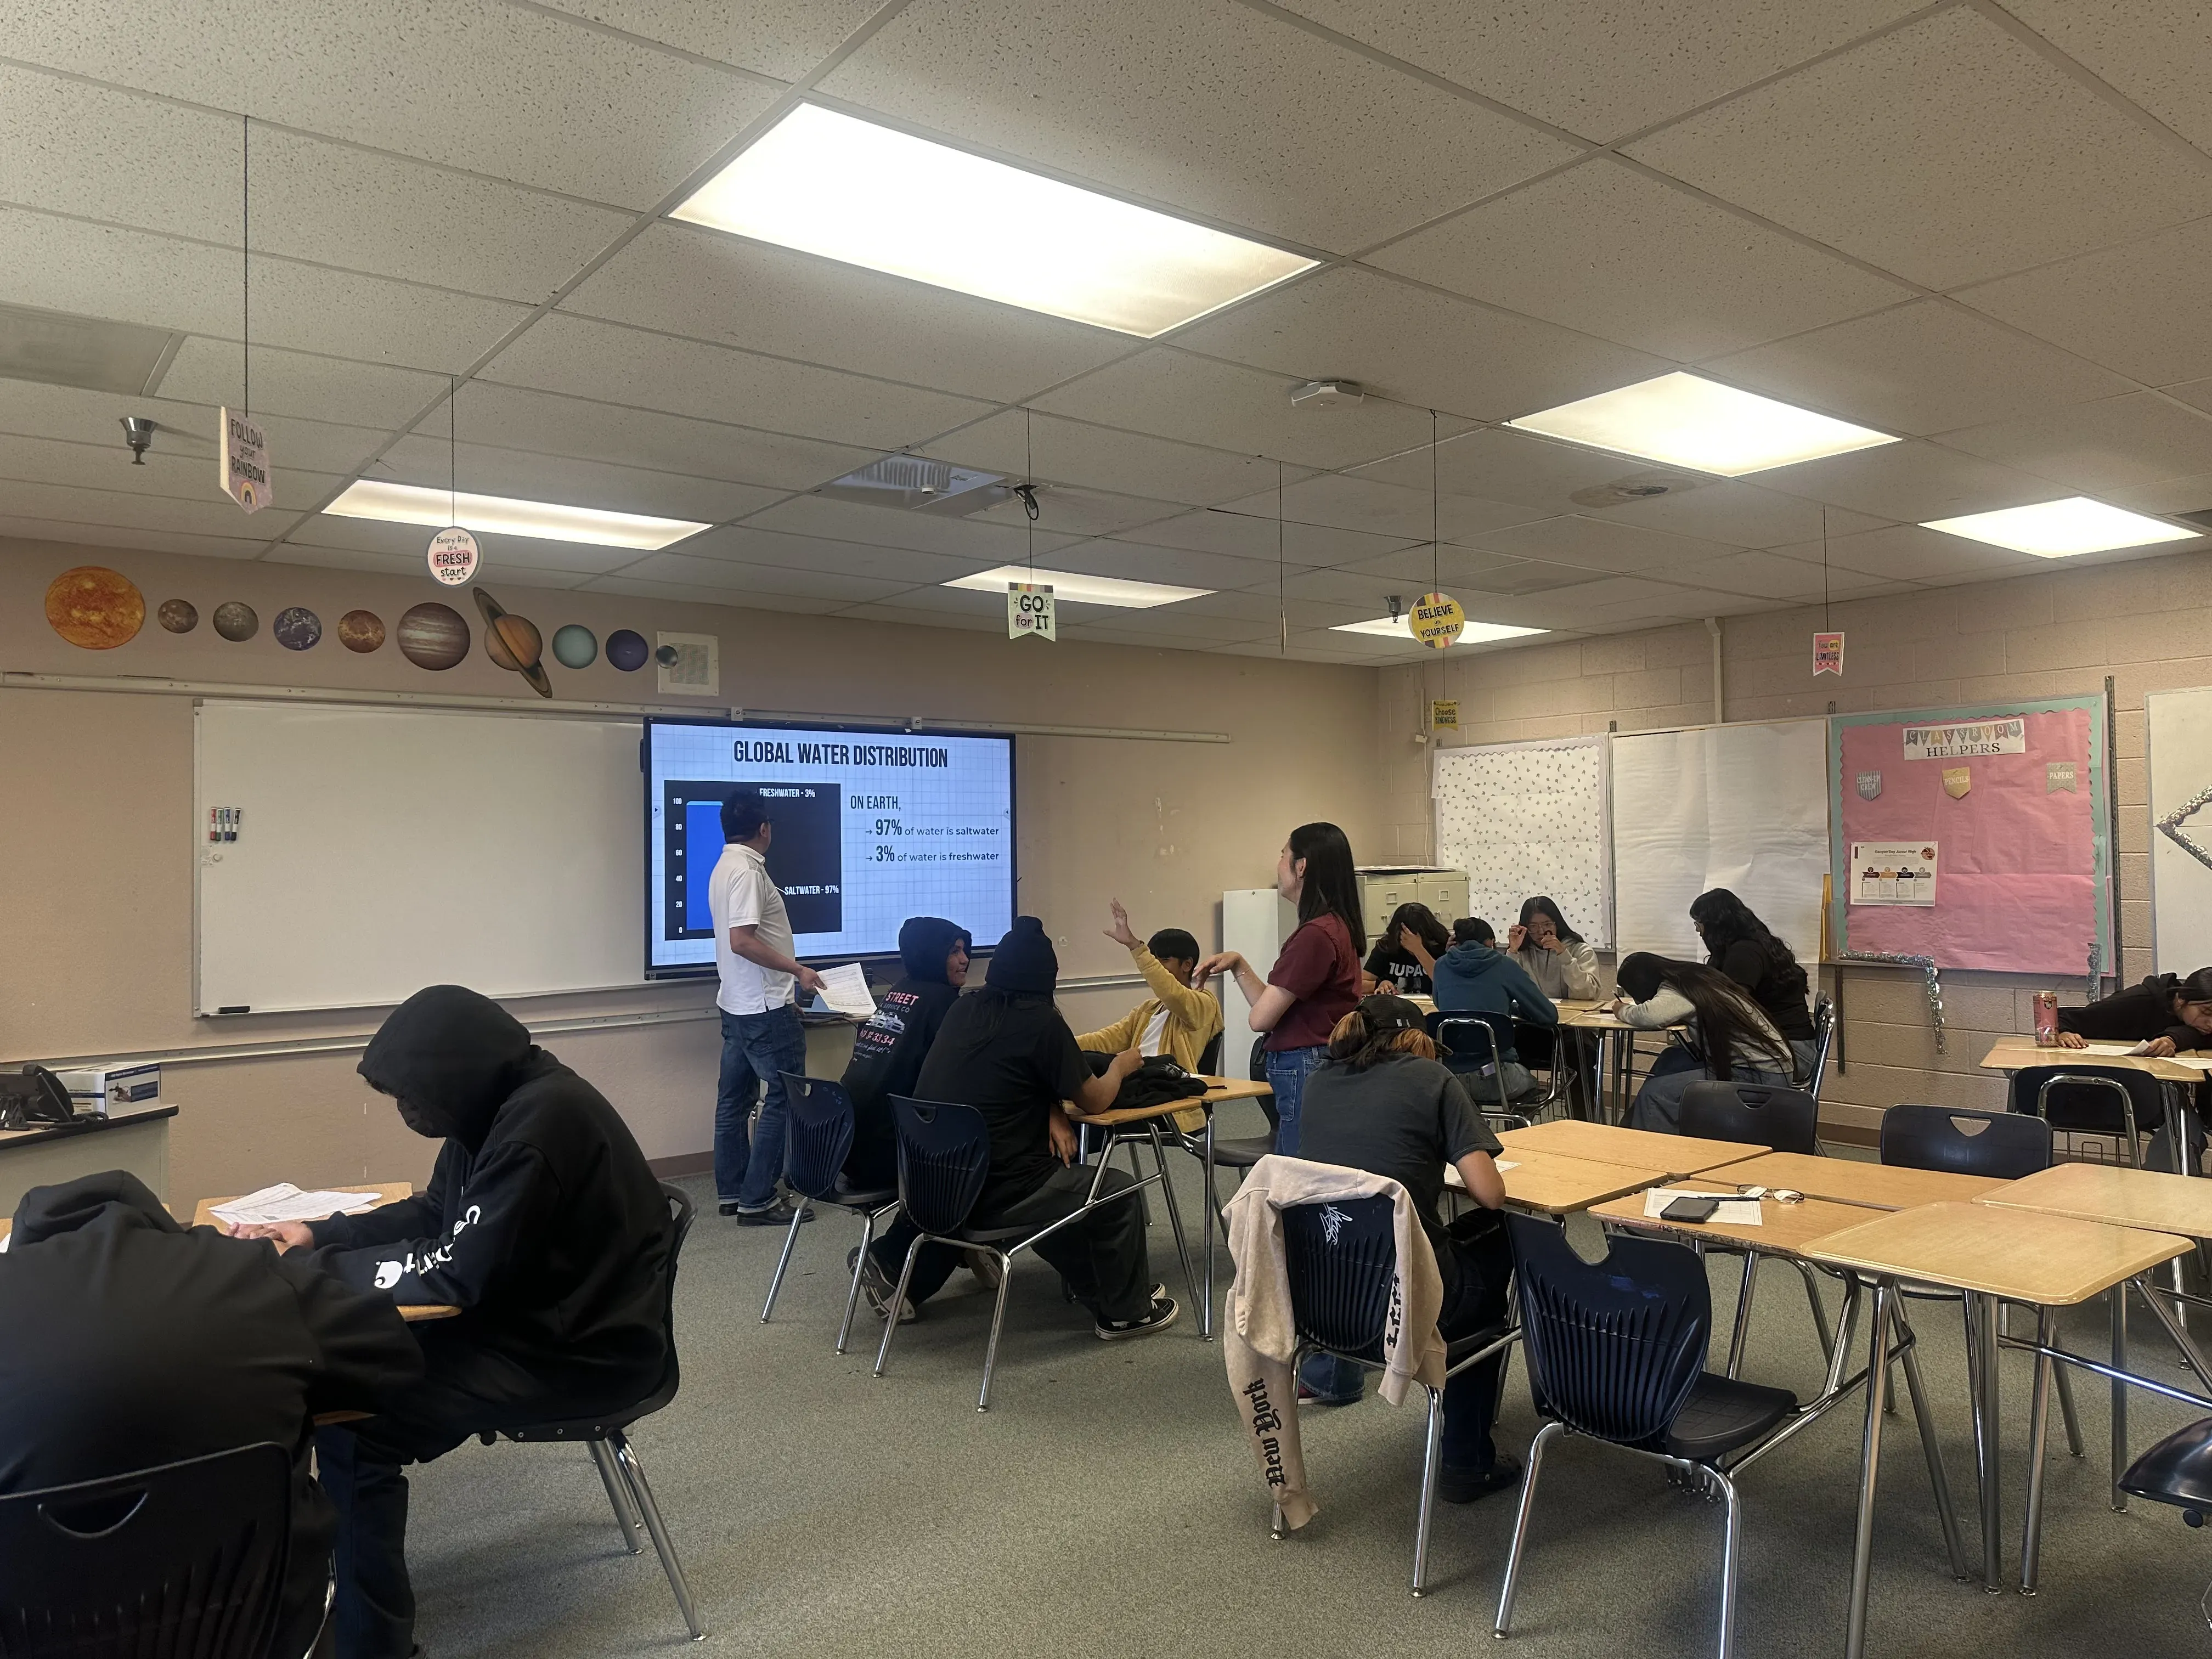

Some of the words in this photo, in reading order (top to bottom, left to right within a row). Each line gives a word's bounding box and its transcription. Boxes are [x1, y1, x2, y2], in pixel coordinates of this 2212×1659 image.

[230, 418, 263, 449] FOLLOW
[239, 445, 256, 459] your
[231, 455, 266, 484] RAINBOW
[458, 535, 470, 545] Day
[436, 552, 470, 565] FRESH
[441, 567, 466, 577] start
[1020, 595, 1044, 612] GO
[1417, 604, 1454, 620] BELIEVE
[1015, 614, 1033, 627] for
[1035, 614, 1049, 630] IT
[1420, 623, 1459, 638] YOURSELF
[1816, 651, 1839, 661] LIMITLESS
[1435, 707, 1456, 715] Choose
[1435, 716, 1457, 725] KINDNESS
[1909, 723, 2019, 741] CLASSROOM
[734, 740, 794, 763] GLOBAL
[798, 743, 849, 765] WATER
[854, 745, 948, 768] DISTRIBUTION
[1926, 742, 2001, 757] HELPERS
[1857, 775, 1880, 783] CLEAN-UP
[1944, 775, 1969, 786] PENCILS
[2049, 771, 2074, 780] PAPERS
[759, 788, 800, 798] FRESHWATER
[805, 789, 815, 798] 3%
[850, 795, 864, 809] ON
[867, 796, 901, 811] EARTH,
[876, 819, 902, 836] 97%
[956, 827, 999, 835] saltwater
[876, 845, 895, 862] 3%
[898, 853, 907, 861] of
[939, 853, 946, 861] is
[949, 853, 999, 861] freshwater
[785, 885, 820, 895] SALTWATER
[825, 885, 839, 894] 97%
[885, 991, 919, 1006] STREET
[1243, 1378, 1282, 1437] York
[1262, 1437, 1286, 1488] New
